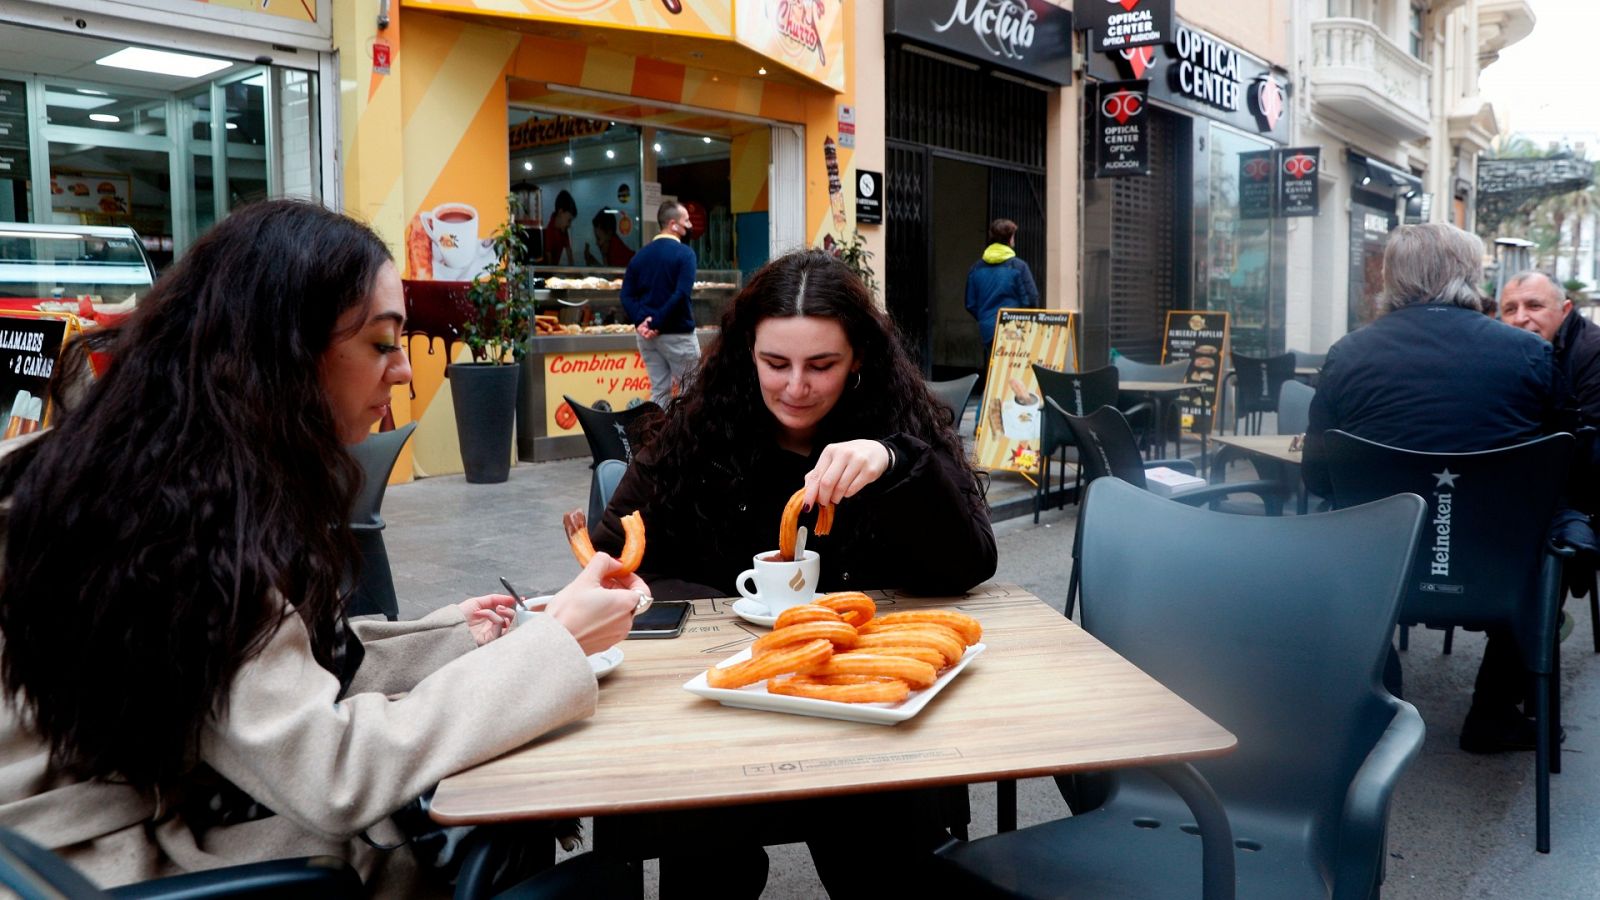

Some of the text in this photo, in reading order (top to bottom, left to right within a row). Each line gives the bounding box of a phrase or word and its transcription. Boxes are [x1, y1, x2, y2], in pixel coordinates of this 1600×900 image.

[1107, 10, 1152, 26] OPTICAL
[1107, 21, 1153, 37] CENTER
[1176, 26, 1243, 83] OPTICAL
[1179, 60, 1241, 111] CENTER
[1105, 125, 1139, 135] OPTICAL
[1105, 134, 1139, 144] CENTER
[14, 354, 22, 375] 2
[23, 353, 54, 379] CAÑAS
[549, 354, 627, 374] Combina
[1431, 493, 1452, 577] Heineken
